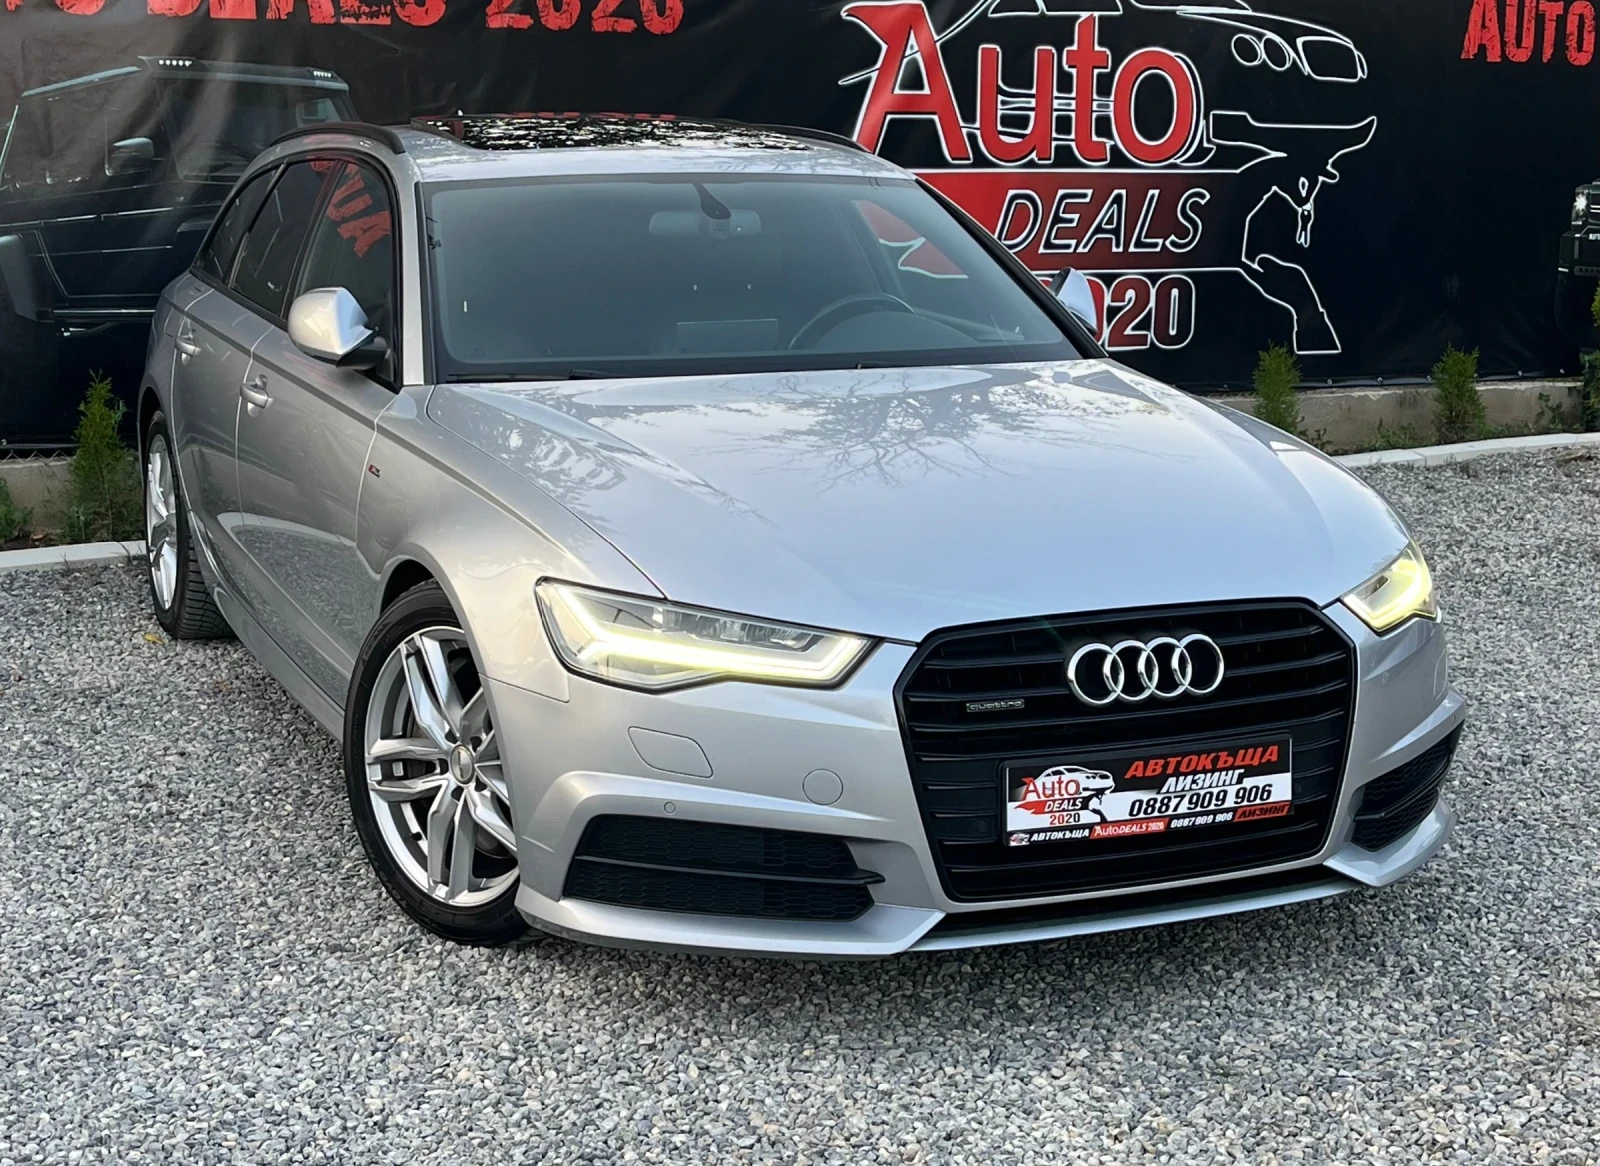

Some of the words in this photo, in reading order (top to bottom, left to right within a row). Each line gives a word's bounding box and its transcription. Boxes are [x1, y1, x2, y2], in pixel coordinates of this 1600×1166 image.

[1460, 0, 1596, 66] AUTO
[842, 1, 1199, 163] Auto
[994, 187, 1211, 253] DEALS
[969, 700, 1022, 712] quattro
[1124, 745, 1279, 779] АВТОКЪЩА
[1021, 775, 1081, 801] Auto
[1160, 768, 1245, 794] ЛИЗИНГ
[1233, 784, 1273, 805] 906
[1044, 798, 1083, 813] DEALS
[1238, 804, 1290, 819] ЛИЗИНГ
[1049, 812, 1081, 826] 2020
[1214, 812, 1234, 823] 906
[1030, 829, 1090, 841] АВТОКЪЩА
